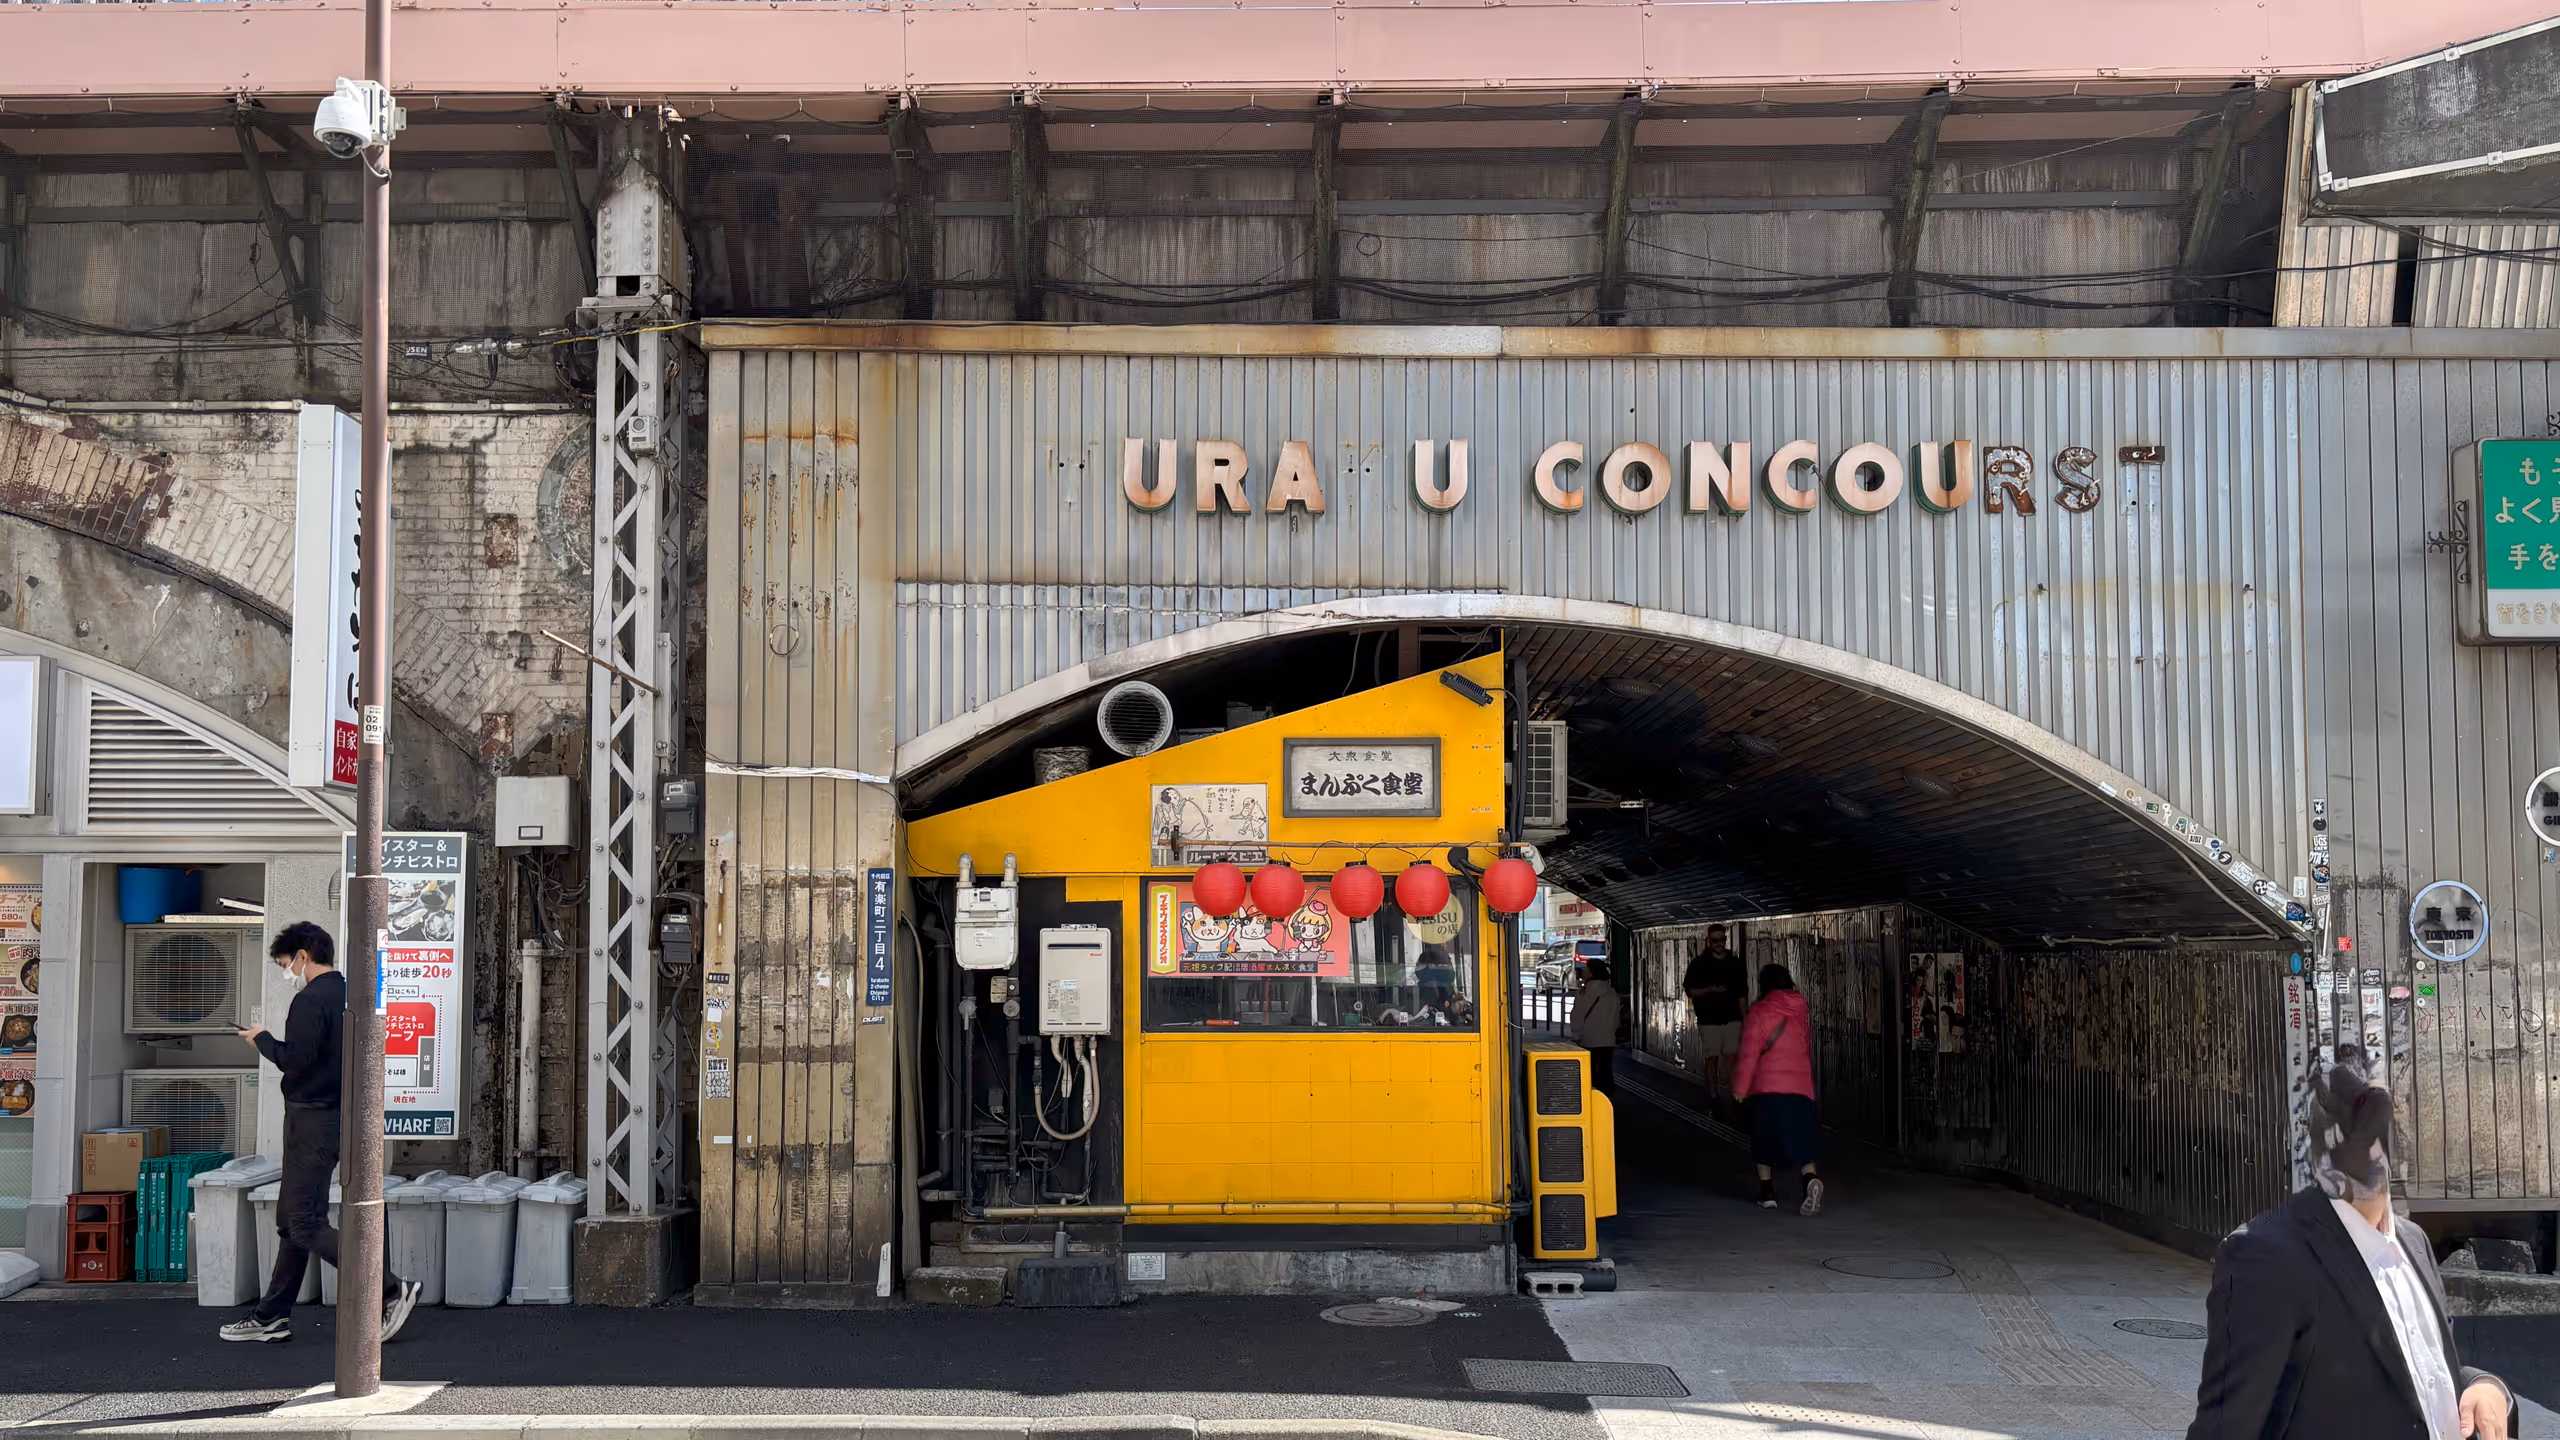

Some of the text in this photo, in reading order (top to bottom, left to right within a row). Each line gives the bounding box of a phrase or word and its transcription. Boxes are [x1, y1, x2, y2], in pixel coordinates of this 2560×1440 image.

[1123, 437, 1325, 516] URA
[1412, 438, 1468, 516] U
[1328, 751, 1393, 762] 大衆食堂
[1300, 771, 1423, 797] まんぷく食堂
